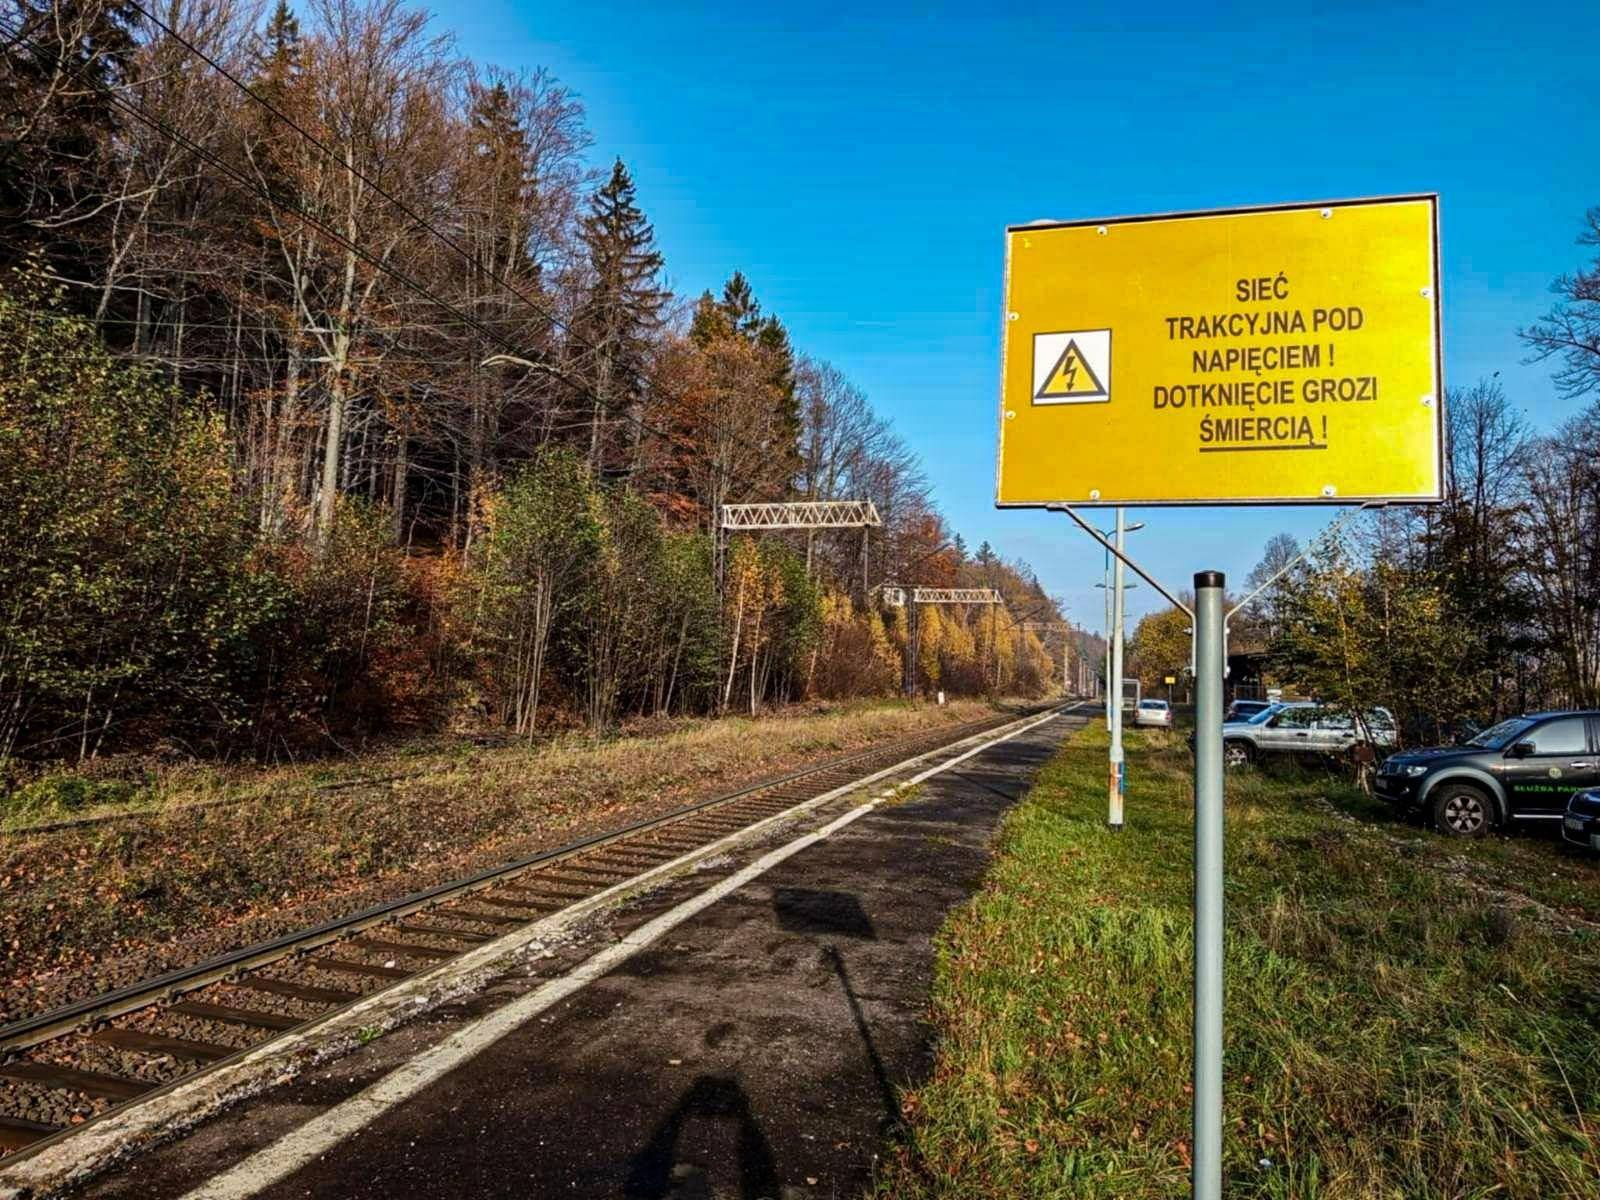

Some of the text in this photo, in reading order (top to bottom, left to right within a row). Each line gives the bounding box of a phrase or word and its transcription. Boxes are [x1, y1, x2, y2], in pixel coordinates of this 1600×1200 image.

[1236, 271, 1289, 302] SIEĆ
[1165, 306, 1364, 341] TRAKCYJNA POD
[1192, 344, 1321, 376] NAPIĘCIEM
[1153, 376, 1378, 411] DOTKNIĘCIE GROZI
[1199, 413, 1313, 446] ŚMIERCIĄ
